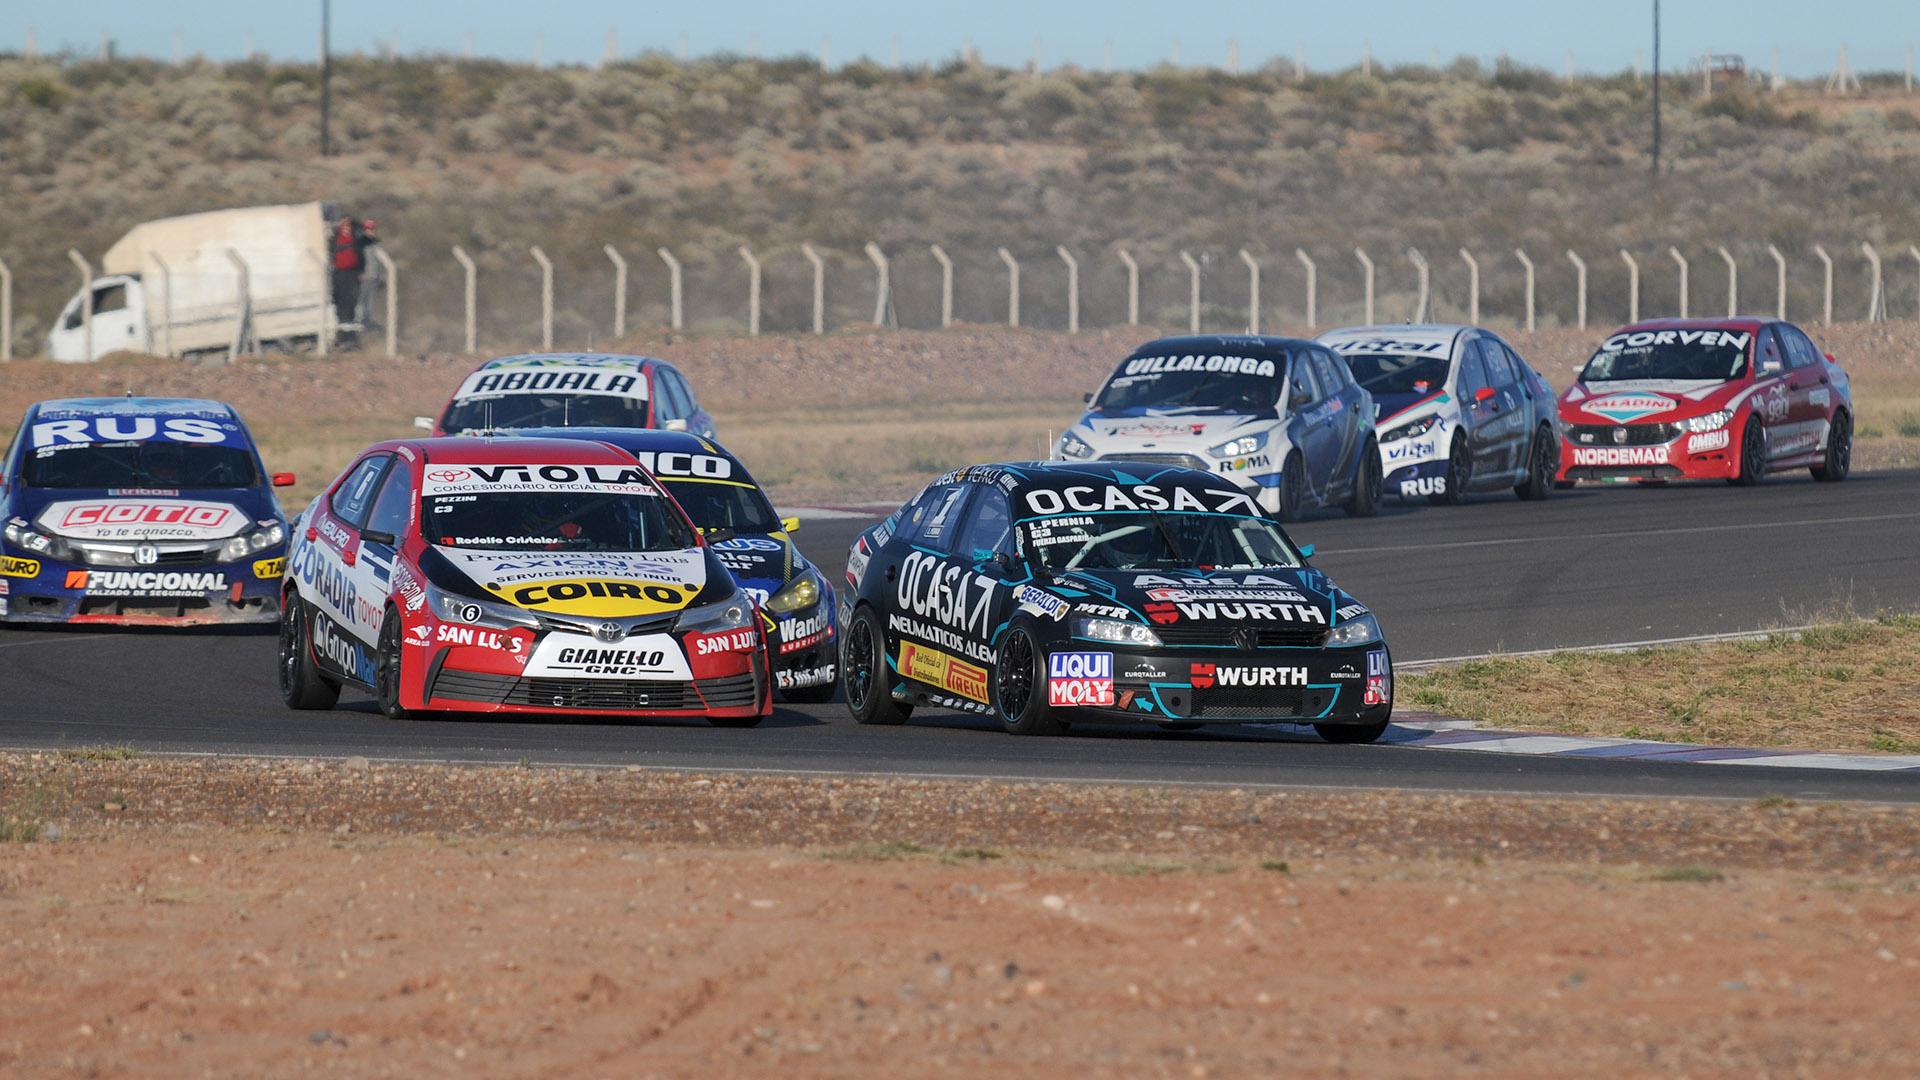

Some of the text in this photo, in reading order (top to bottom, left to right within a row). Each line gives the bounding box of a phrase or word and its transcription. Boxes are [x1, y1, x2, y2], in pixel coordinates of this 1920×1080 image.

[1602, 331, 1751, 351] CORVEN
[1126, 355, 1275, 377] VILLALONGA
[473, 372, 637, 393] ABDALA
[1587, 395, 1672, 409] PALADINI
[33, 418, 226, 447] RUS
[1573, 448, 1669, 464] NORDEMAQ
[433, 483, 656, 494] CONCESIONARIO OFICIAL TOYOTA
[1400, 477, 1446, 496] RUS
[62, 504, 229, 527] COTO
[433, 506, 453, 514] C3
[96, 528, 112, 537] Yo
[116, 528, 129, 537] te
[1029, 517, 1095, 530] L.PERNIA
[455, 535, 559, 546] Rodolfo Cristales
[711, 538, 782, 551] US
[1032, 537, 1057, 547] FUERZA
[464, 552, 690, 567] Previsora San Luis
[492, 559, 628, 572] AXION
[88, 571, 228, 591] FUNCIONAL
[294, 538, 357, 625] CORADIR
[496, 570, 682, 584] SERVICENTRO LAFINUR
[86, 589, 129, 597] CALZADO
[149, 589, 205, 598] SEGURIDAD
[514, 581, 683, 605] COIRO
[1020, 587, 1061, 615] BERALDI
[358, 597, 383, 633] TOYOT
[464, 604, 479, 621] 6
[1073, 603, 1130, 619] MTR
[437, 625, 524, 654] SAN LUS
[697, 636, 729, 656] SAN
[889, 613, 964, 655] NEUMATICOS
[964, 640, 998, 667] ALEM
[558, 651, 664, 667] GIANELLO
[1050, 653, 1110, 679] LIQUI
[582, 666, 638, 676] GNC
[1125, 671, 1166, 679] EUROTALLER
[1216, 667, 1307, 686] WÜRTH
[947, 659, 988, 702] PIRELLI
[1050, 679, 1112, 704] MOLY
